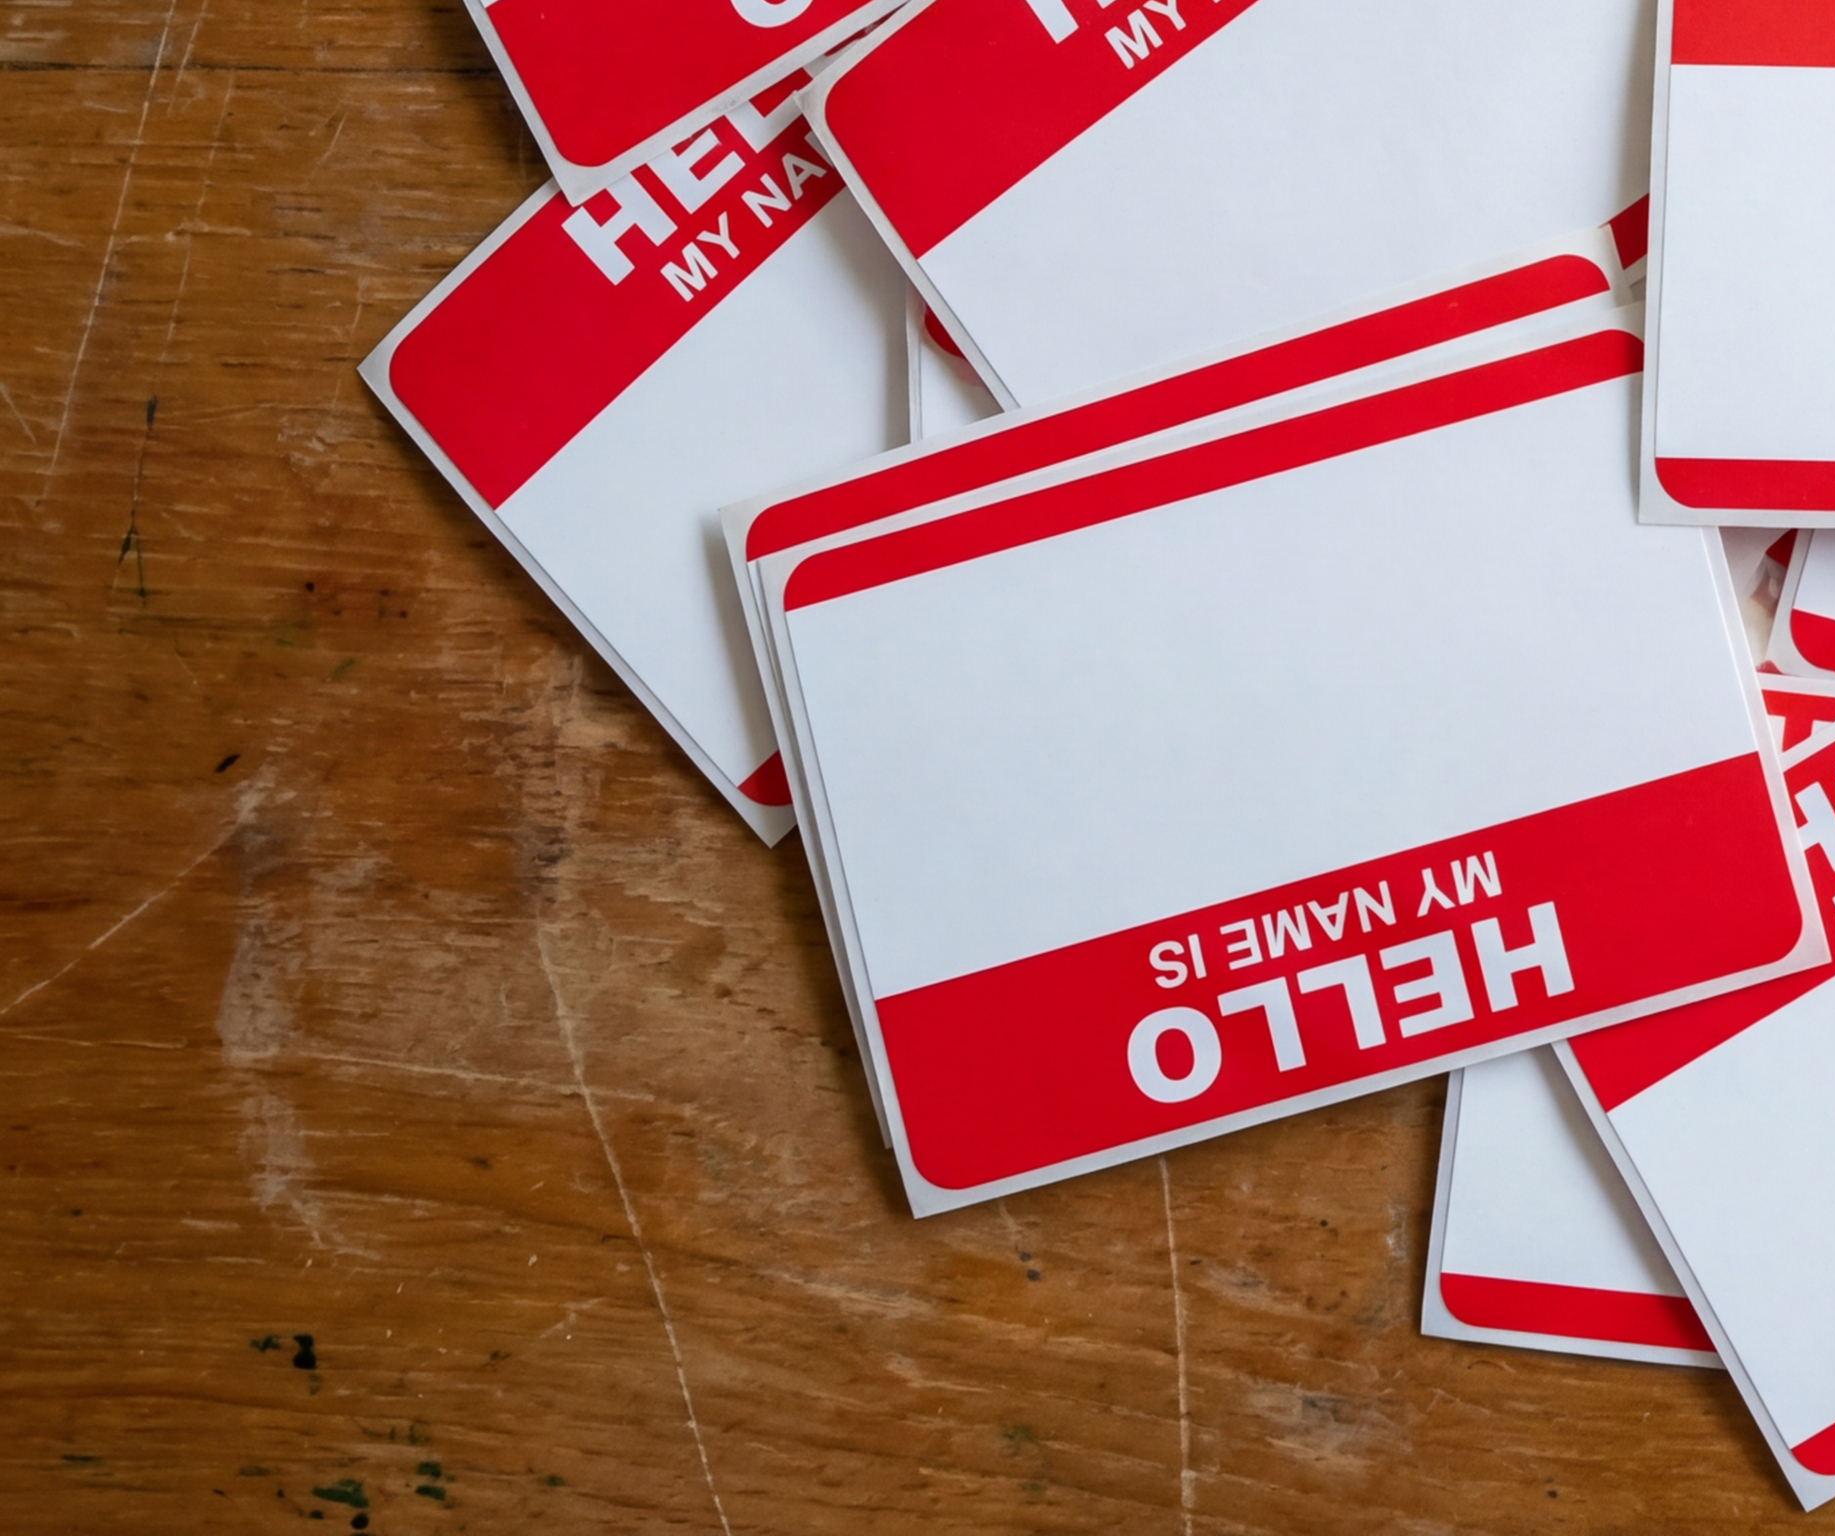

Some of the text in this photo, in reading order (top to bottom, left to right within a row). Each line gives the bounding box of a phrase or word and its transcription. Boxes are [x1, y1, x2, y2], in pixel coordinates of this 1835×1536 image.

[561, 90, 803, 286] HEL
[661, 129, 836, 301] MY NA
[1128, 902, 1574, 1103] HELLO
[1150, 851, 1501, 988] MY NAME IS
